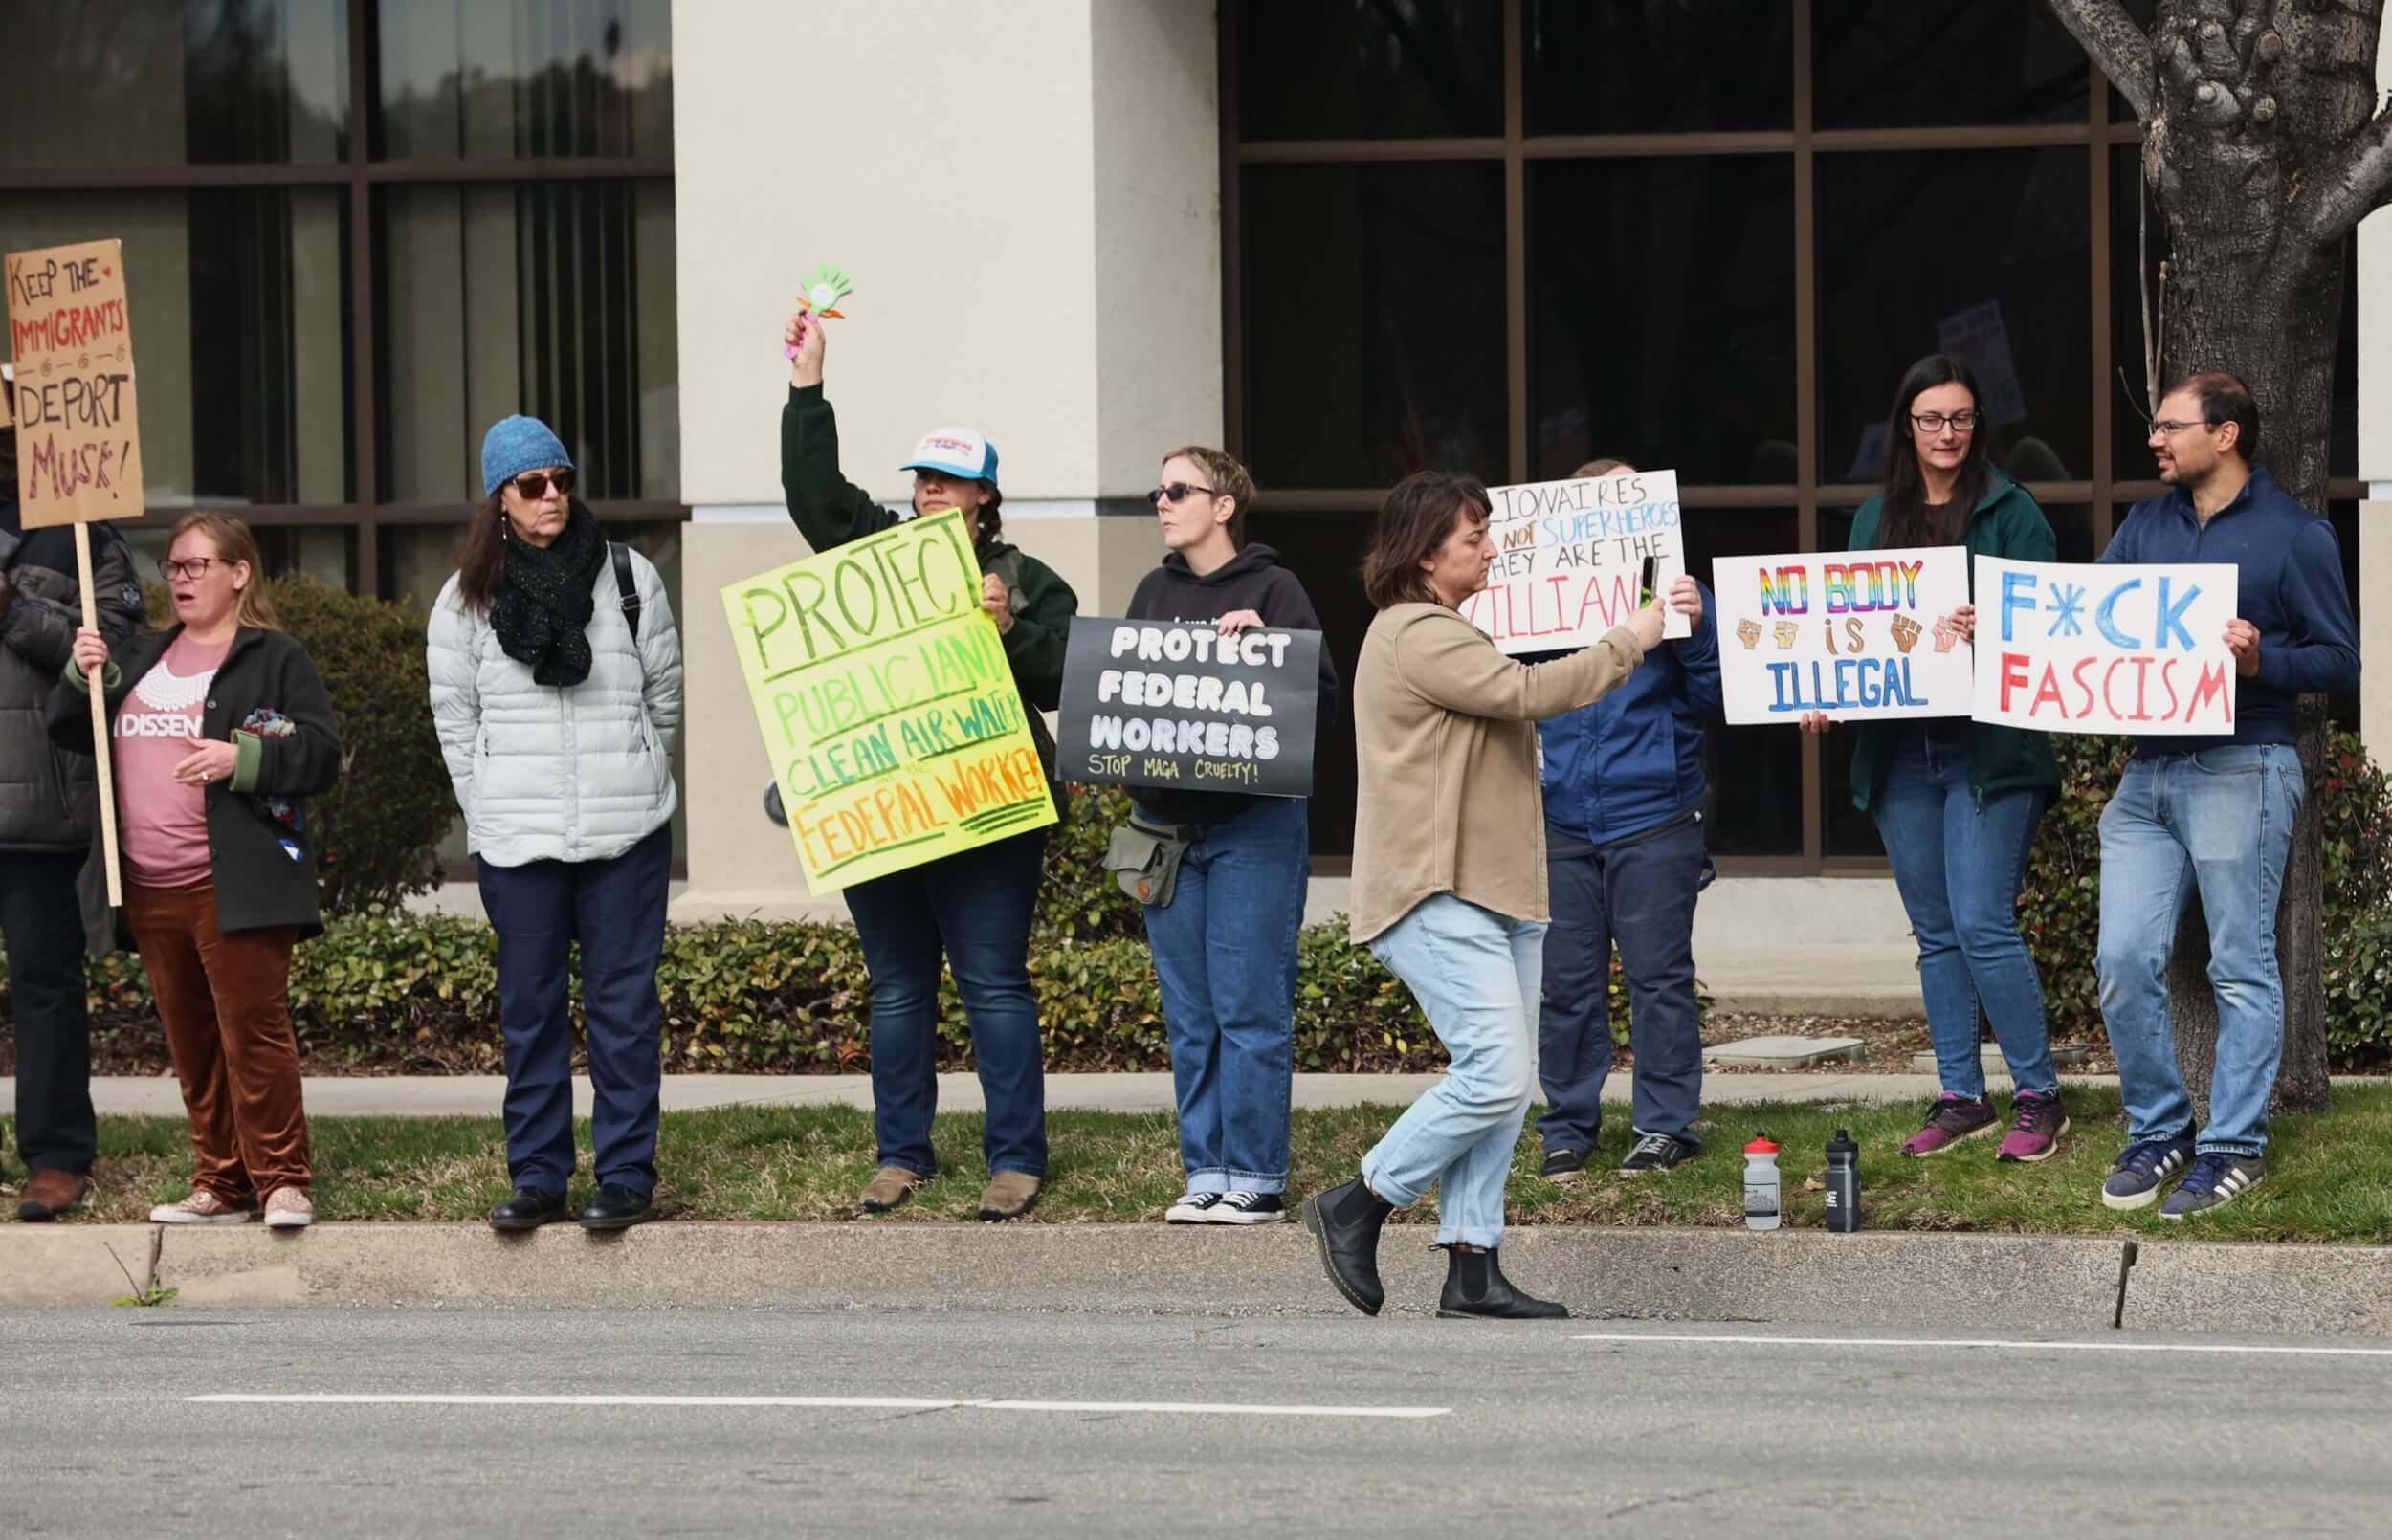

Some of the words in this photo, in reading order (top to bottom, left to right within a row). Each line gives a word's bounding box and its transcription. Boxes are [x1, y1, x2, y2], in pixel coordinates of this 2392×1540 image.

[10, 258, 57, 306] KEEP
[62, 258, 99, 293] THE
[12, 298, 123, 362] IMMIGRANTS
[19, 374, 129, 429] DEPORT
[28, 432, 130, 499] MUSK!
[1490, 477, 1647, 523] IONAIRES
[1491, 552, 1535, 580] HEY
[1555, 539, 1605, 568] ARE
[1613, 533, 1670, 562] THE
[1502, 521, 1538, 549] NOT
[742, 513, 982, 669] PROTECT
[1759, 565, 1809, 616] NO
[1824, 560, 1924, 613] BODY
[1111, 627, 1291, 668] PROTECT
[772, 655, 916, 747] PUBLIC
[1098, 671, 1272, 717] FEDERAL
[1766, 657, 1929, 713] ILLEGAL
[2000, 651, 2233, 723] FASCISM
[122, 714, 204, 738] DISSEN
[1089, 715, 1279, 759] WORKERS
[787, 723, 900, 798] CLEAN
[1088, 754, 1132, 777] STOP
[1144, 759, 1179, 780] MAGA
[1195, 759, 1258, 784] CRUELTY!
[792, 780, 949, 869] FEDERAL
